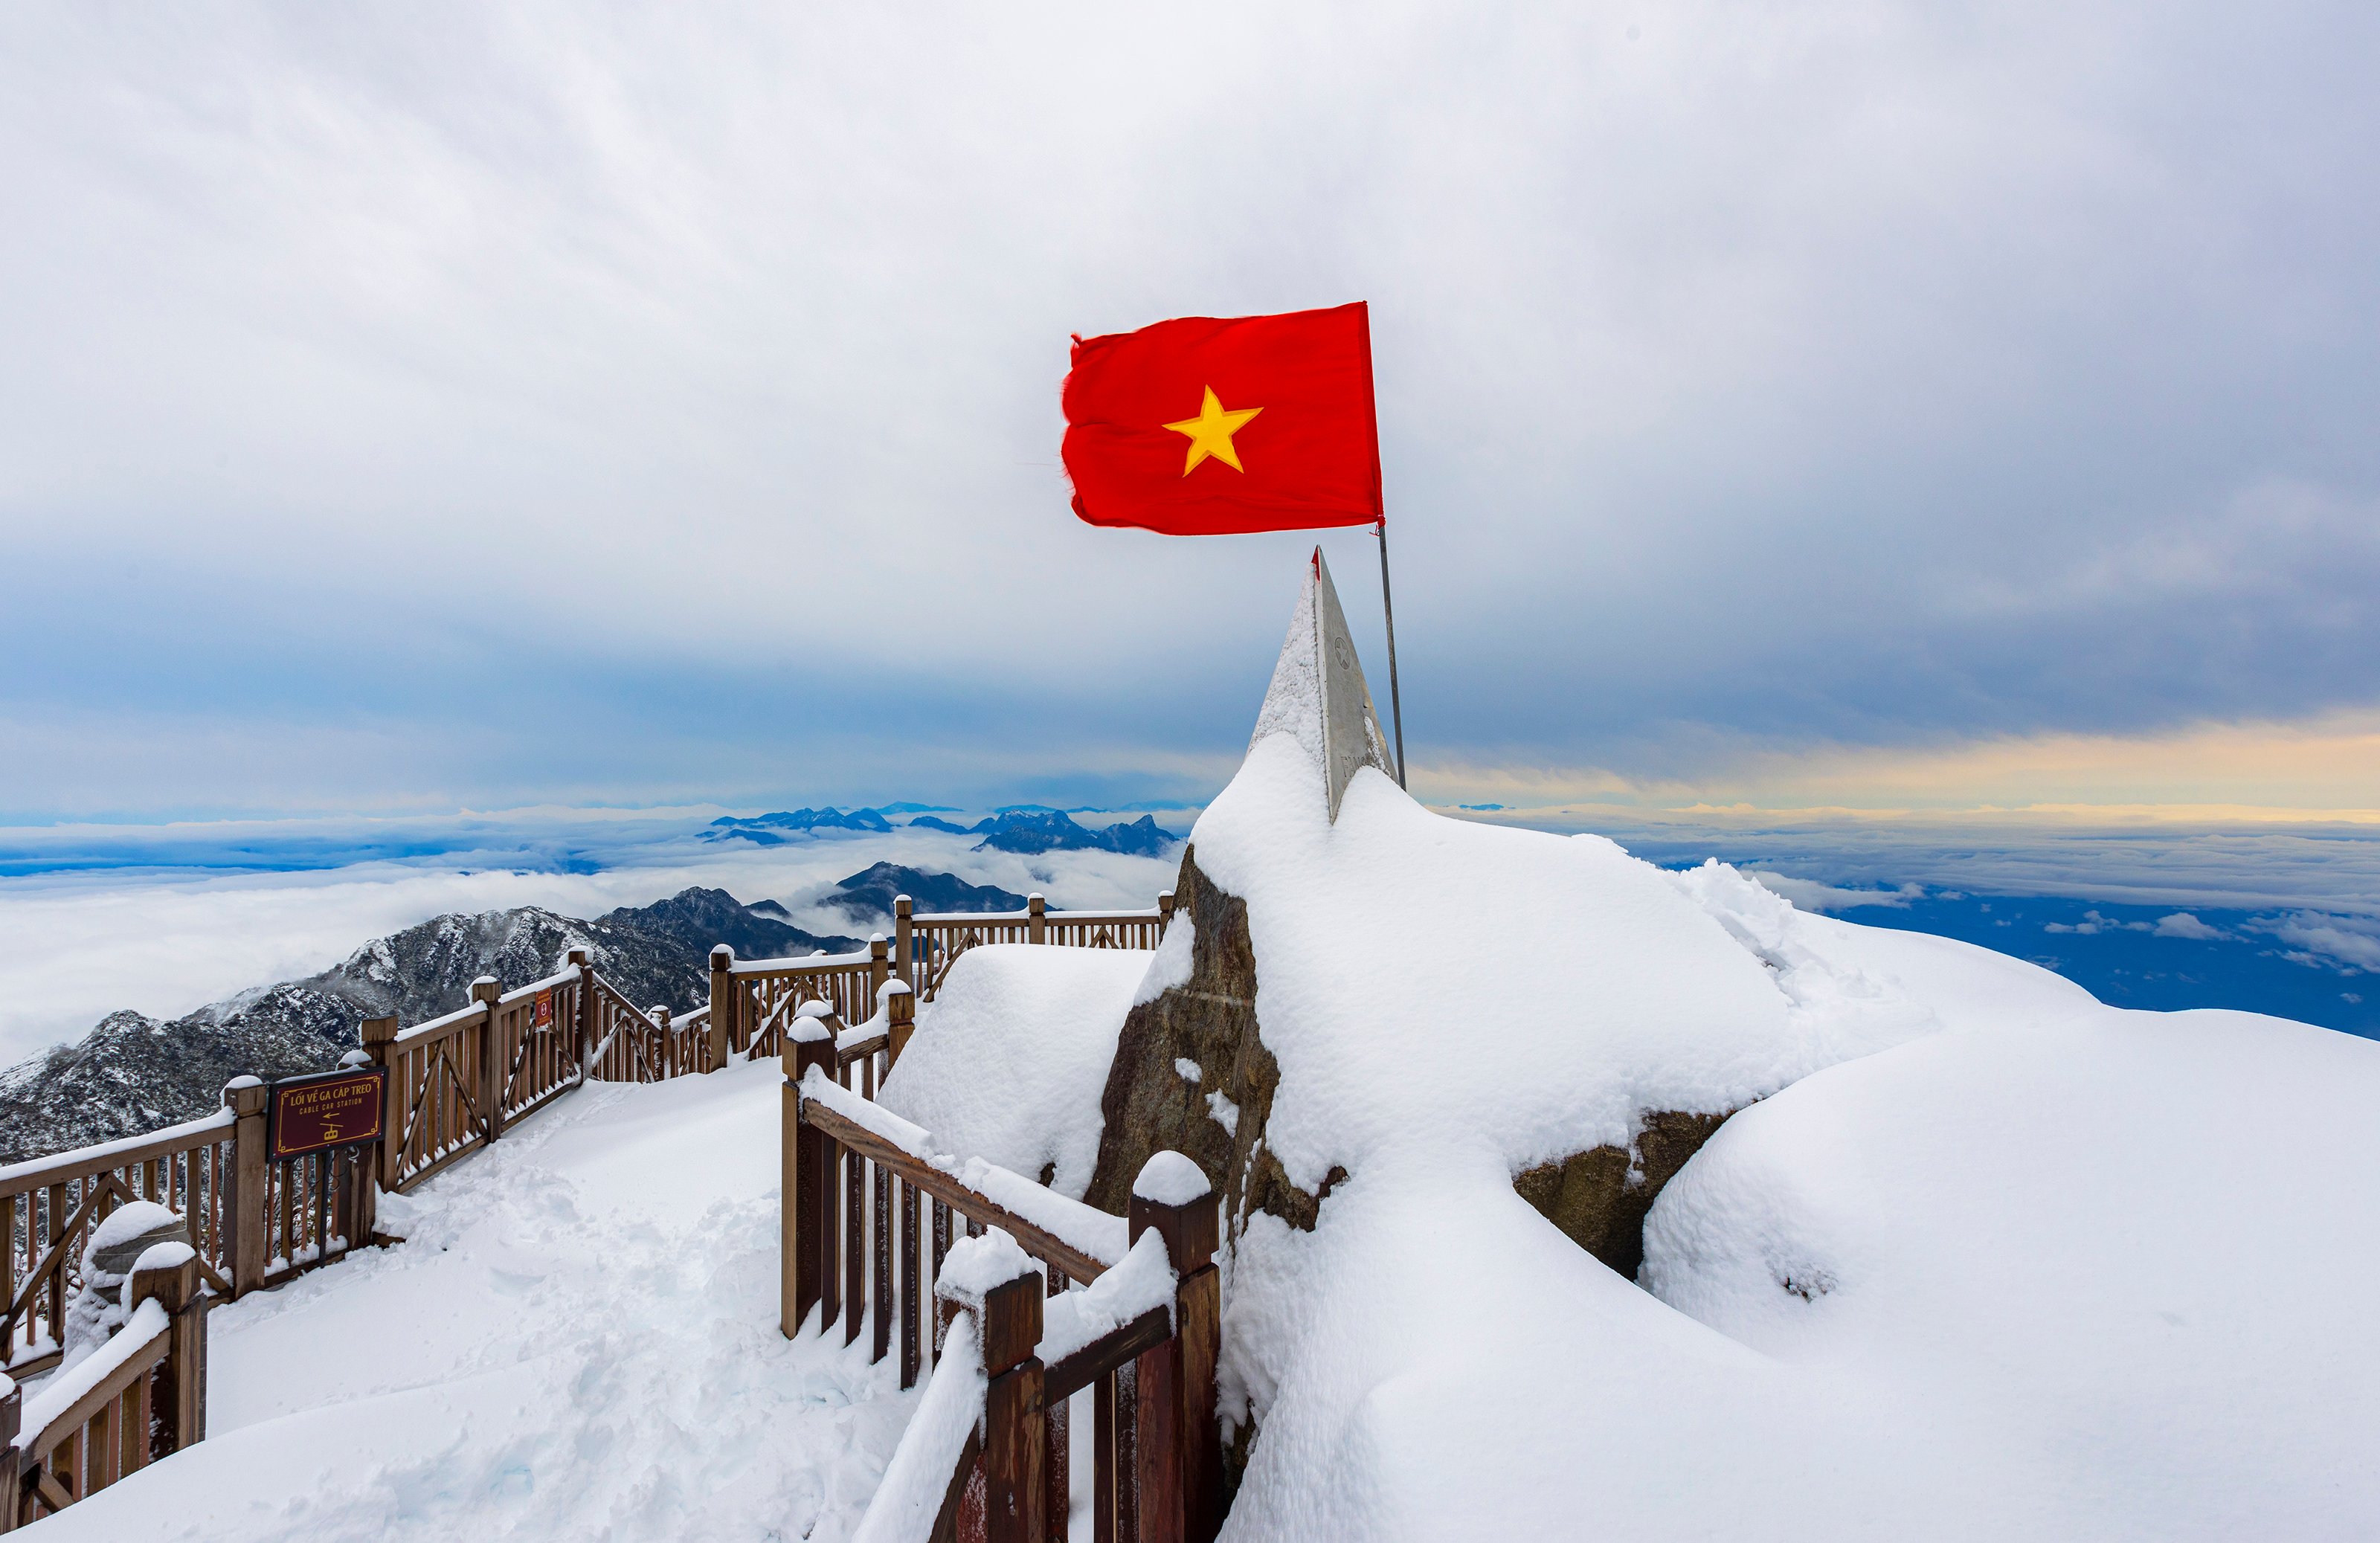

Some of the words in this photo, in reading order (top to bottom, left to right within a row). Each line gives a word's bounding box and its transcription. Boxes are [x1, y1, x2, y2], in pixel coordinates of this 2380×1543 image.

[290, 1092, 304, 1106] LỐI
[319, 1091, 331, 1101] GA
[332, 1086, 350, 1098] CÁP
[350, 1083, 372, 1095] TREO
[299, 1105, 319, 1115] CABLE
[322, 1103, 334, 1111] CAR
[337, 1098, 362, 1108] STATION
